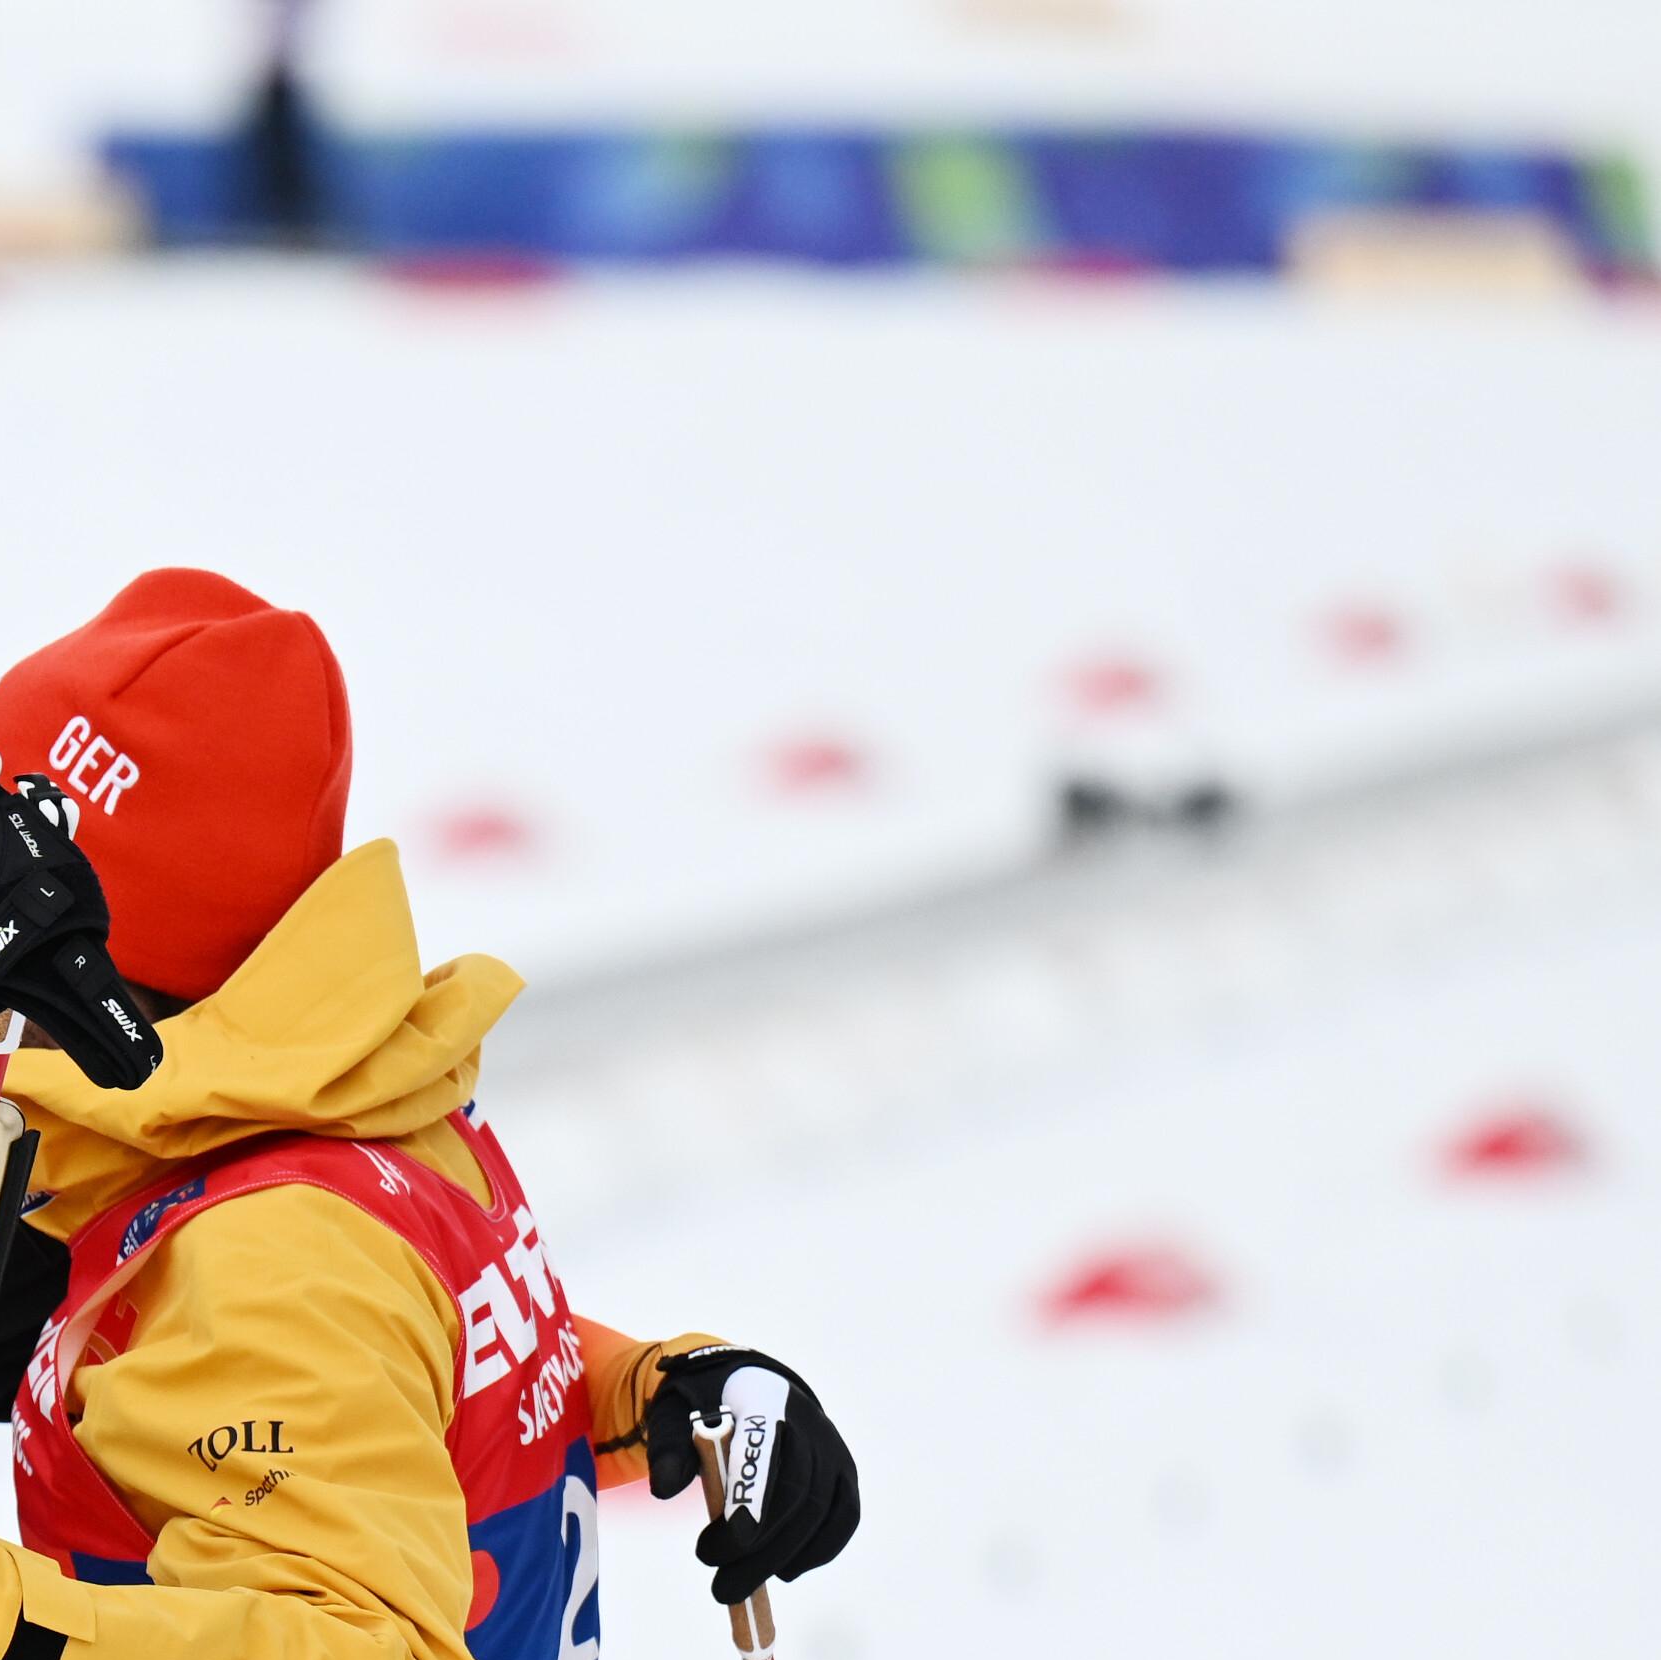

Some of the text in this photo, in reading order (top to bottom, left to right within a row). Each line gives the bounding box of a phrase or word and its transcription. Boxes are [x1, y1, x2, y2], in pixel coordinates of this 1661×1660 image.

[49, 716, 140, 816] GER
[74, 955, 87, 969] R
[187, 1420, 294, 1472] ZOLL
